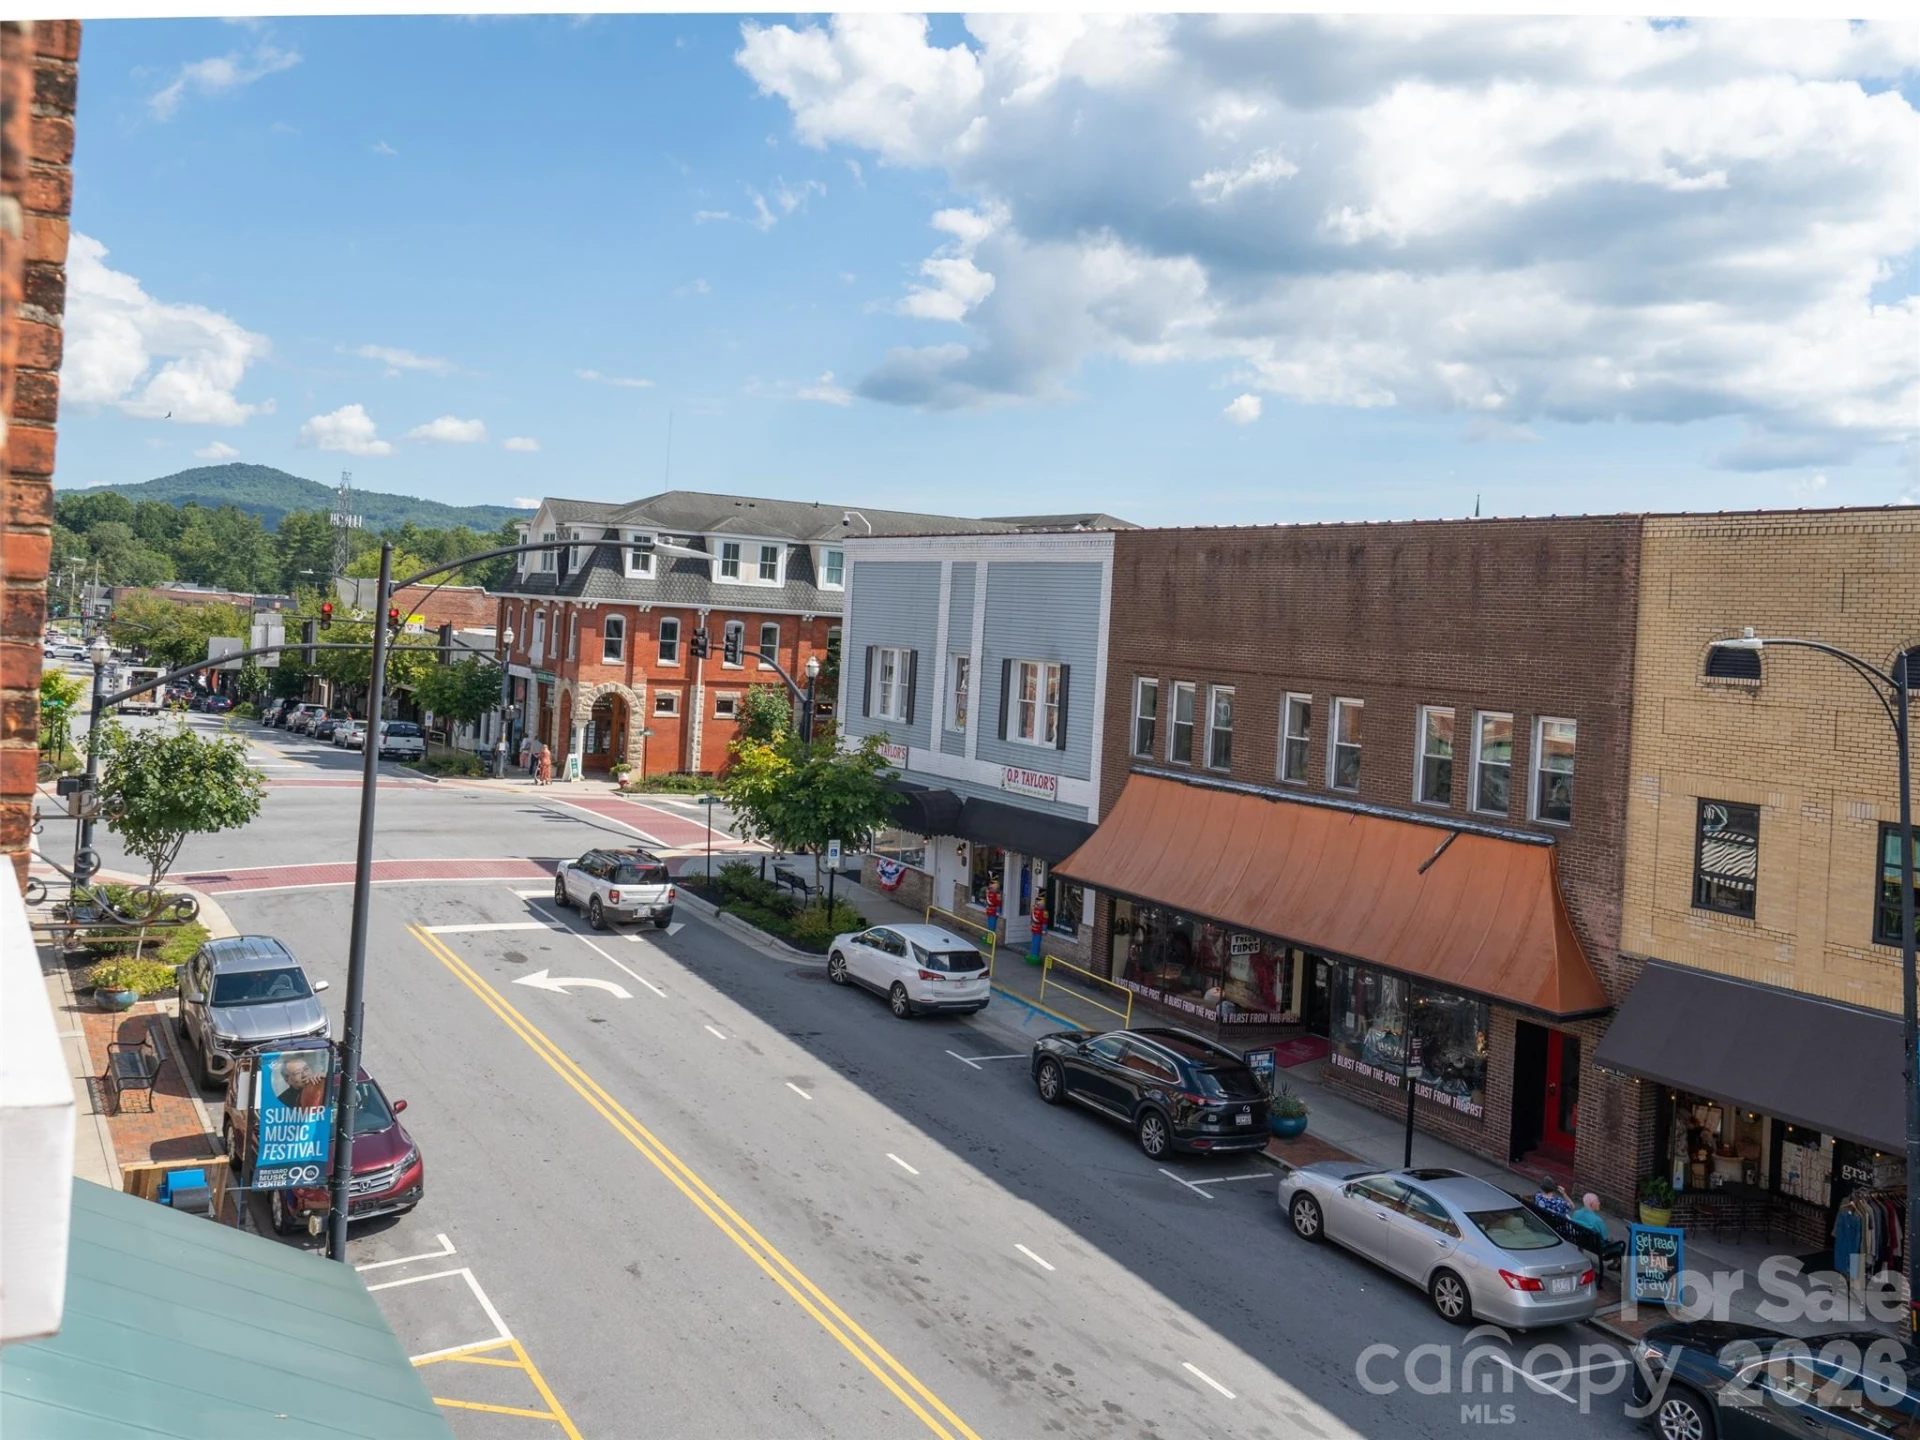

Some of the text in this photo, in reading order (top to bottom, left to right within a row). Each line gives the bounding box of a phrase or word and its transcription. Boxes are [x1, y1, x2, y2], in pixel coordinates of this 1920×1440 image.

[879, 742, 906, 760] TAYLOR'S
[1006, 769, 1019, 783] O.P.
[1021, 771, 1055, 791] TAYLOR'S
[1140, 985, 1149, 996] THE
[1148, 988, 1160, 1001] PAST
[1168, 996, 1182, 1008] BLAST
[1182, 1000, 1195, 1014] FROM
[1196, 1005, 1204, 1018] THE
[1204, 1008, 1217, 1022] PAST
[1222, 1013, 1228, 1024] A
[1250, 1013, 1268, 1023] FROM
[1269, 1013, 1282, 1023] THE
[1332, 1053, 1337, 1064] A
[1337, 1055, 1355, 1071] BLAST
[1355, 1061, 1372, 1076] FROM
[1373, 1068, 1384, 1082] THE
[1384, 1072, 1401, 1088] PAST
[1433, 1090, 1451, 1107] FROM
[1453, 1096, 1466, 1111] THE
[1465, 1102, 1483, 1118] PAST
[265, 1106, 326, 1124] SUMMER
[264, 1124, 310, 1142] MUSIC
[262, 1141, 323, 1160] FESTIVAL
[258, 1180, 287, 1188] CENTER
[288, 1165, 320, 1185] 90
[1636, 1233, 1677, 1257] get ready
[1638, 1252, 1674, 1270] to FALL
[1646, 1267, 1664, 1280] into
